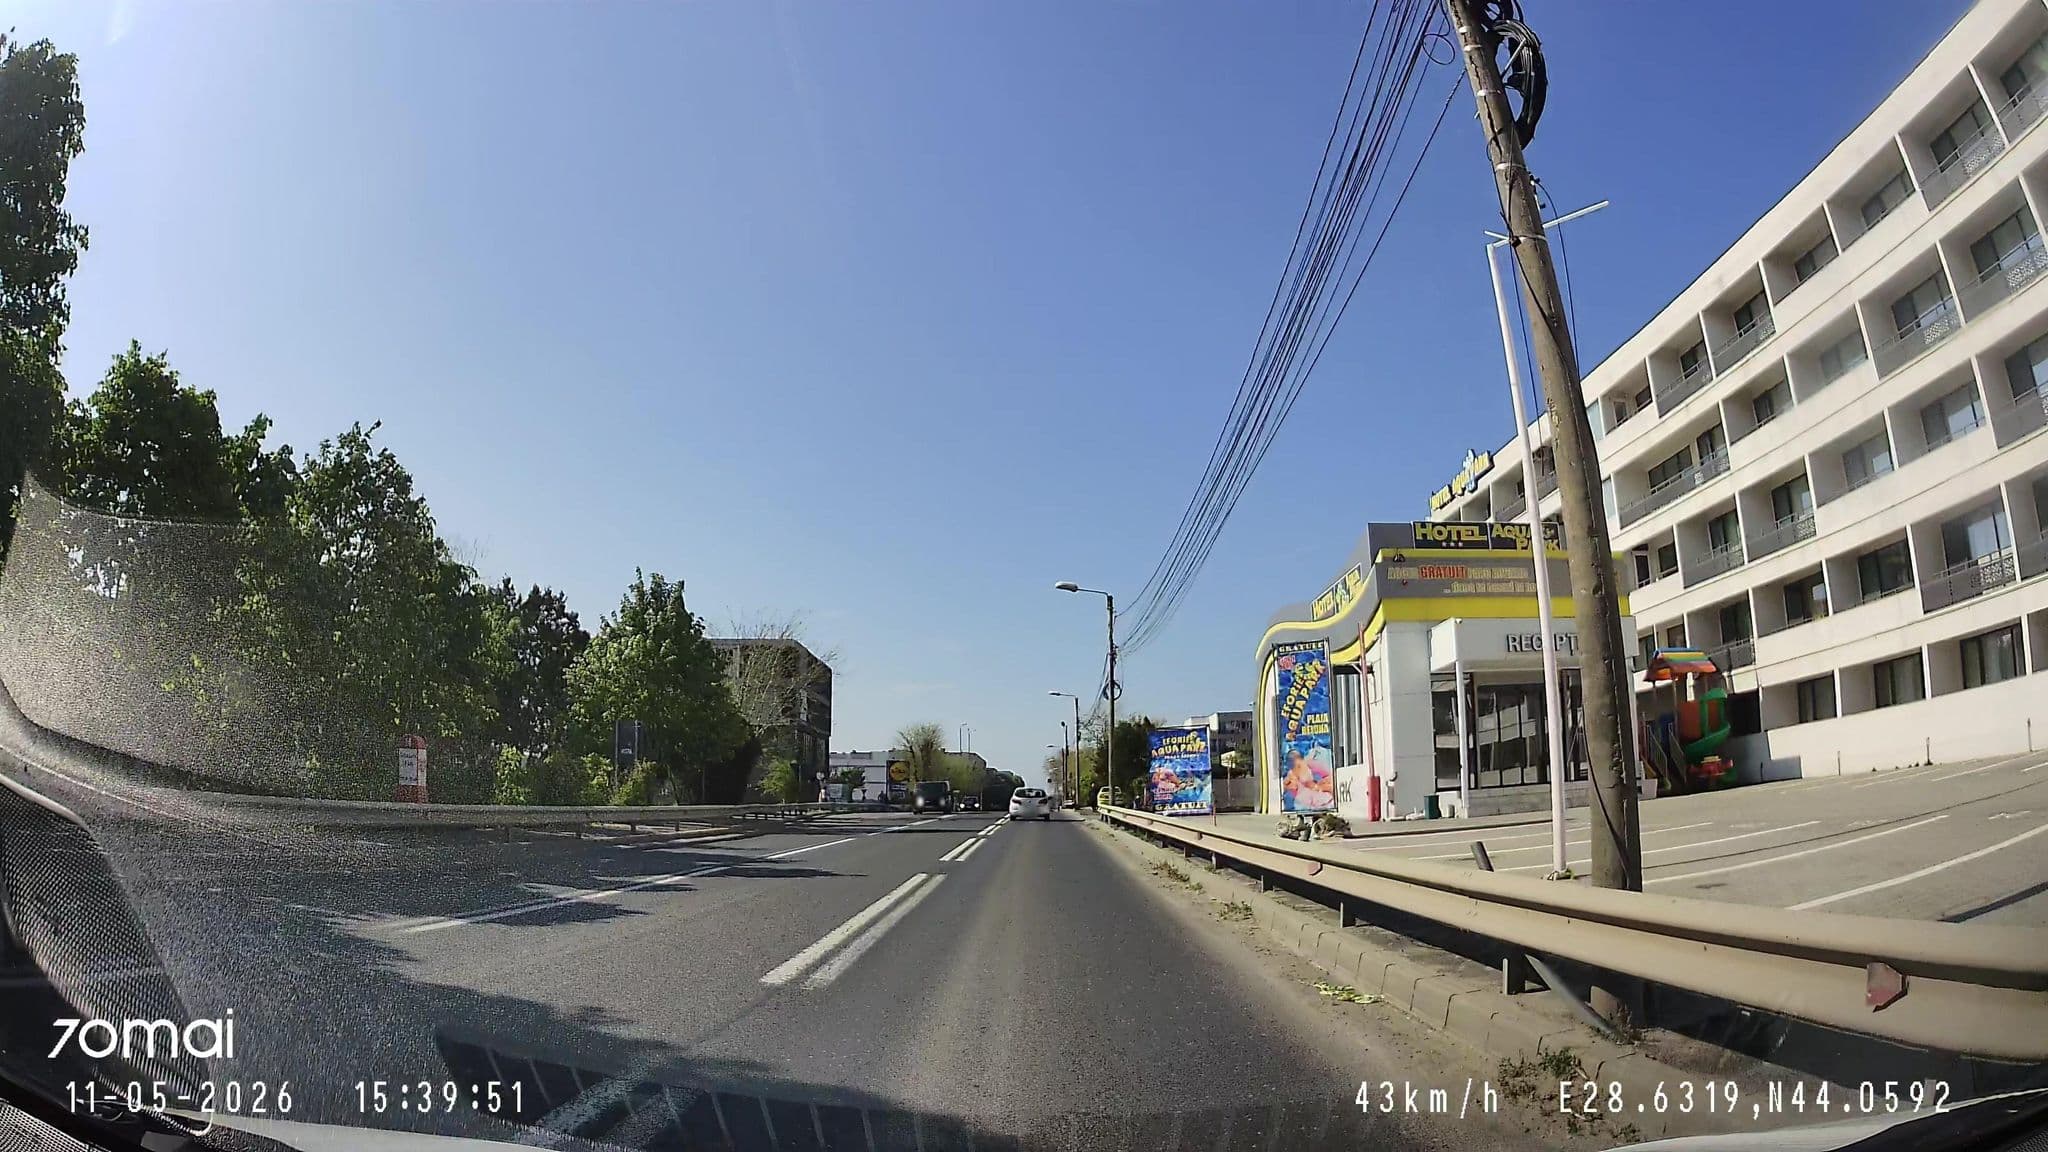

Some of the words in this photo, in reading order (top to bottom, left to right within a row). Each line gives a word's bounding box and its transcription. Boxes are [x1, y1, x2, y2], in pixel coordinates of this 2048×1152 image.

[1415, 522, 1488, 541] HOTEL
[1516, 537, 1560, 552] PK
[1418, 565, 1466, 580] GRATUIT
[1506, 634, 1579, 652] RECPT
[1285, 699, 1307, 742] AQUA
[1151, 745, 1179, 758] AQUA
